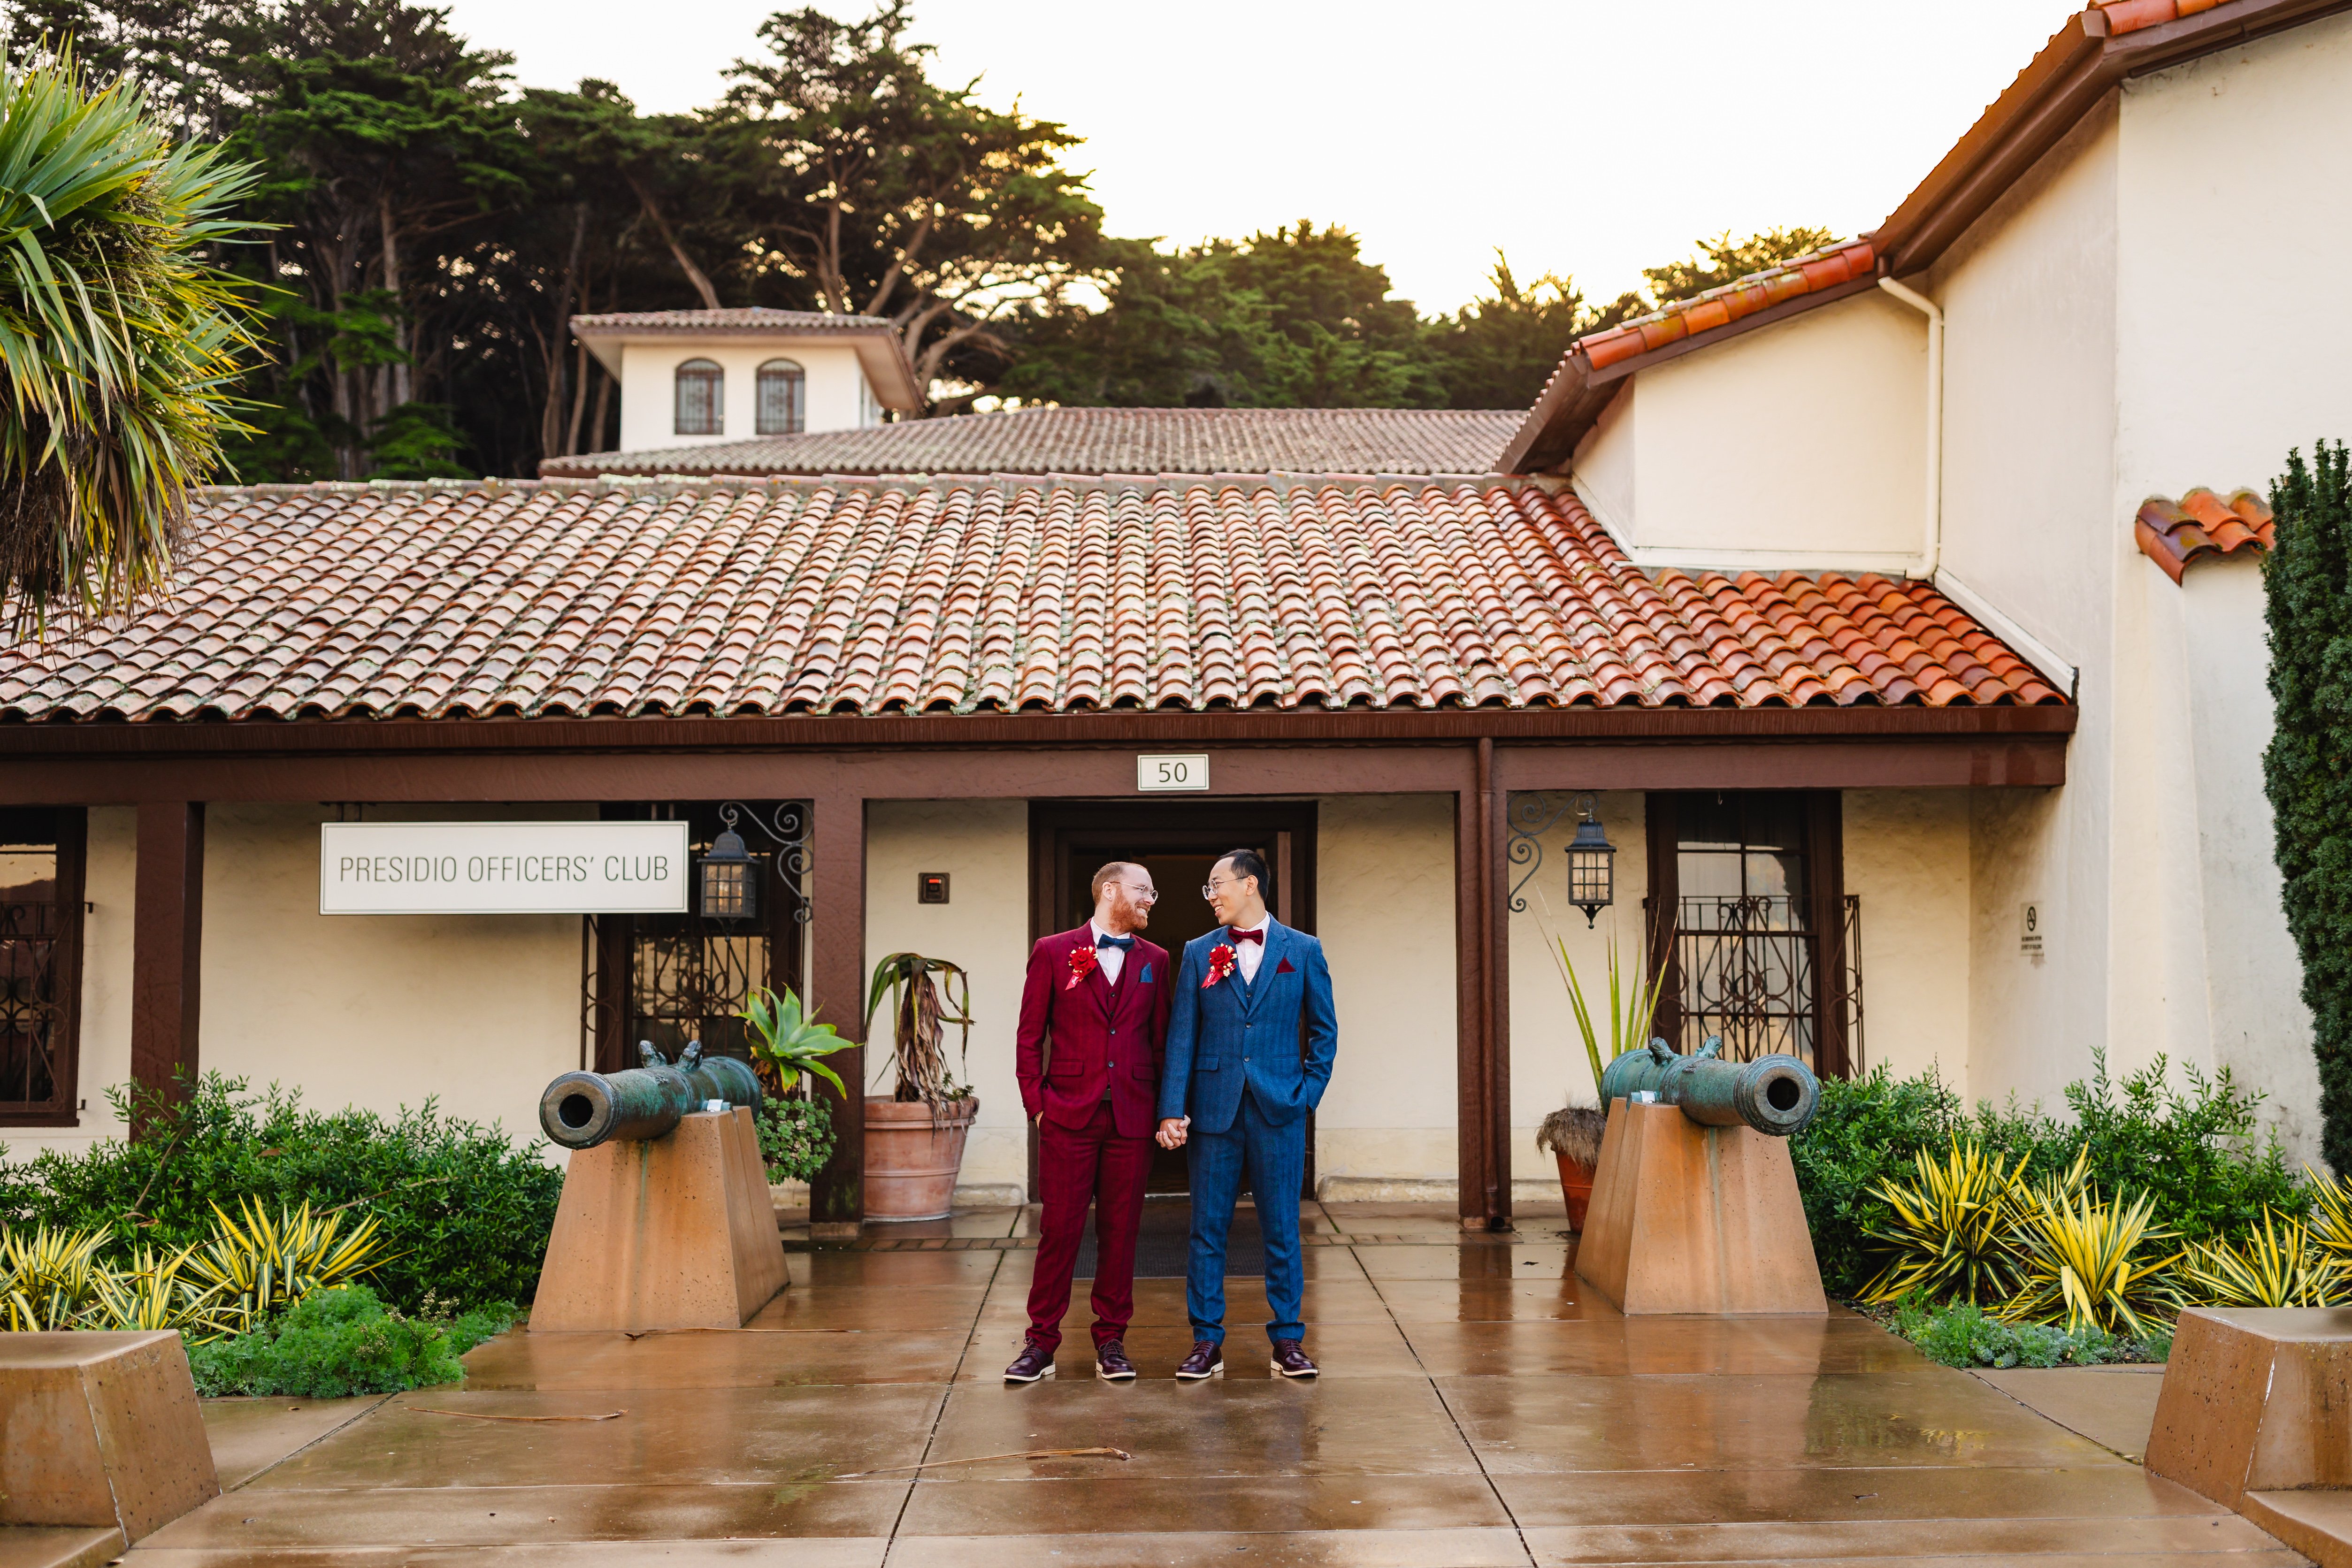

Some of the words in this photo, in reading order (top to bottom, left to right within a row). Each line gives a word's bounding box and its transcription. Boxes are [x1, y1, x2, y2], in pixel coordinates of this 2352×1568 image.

[1159, 762, 1187, 783] 50
[340, 856, 457, 882] PRESIDIO
[468, 856, 594, 882] OFFICERS’
[605, 856, 668, 882] CLUB
